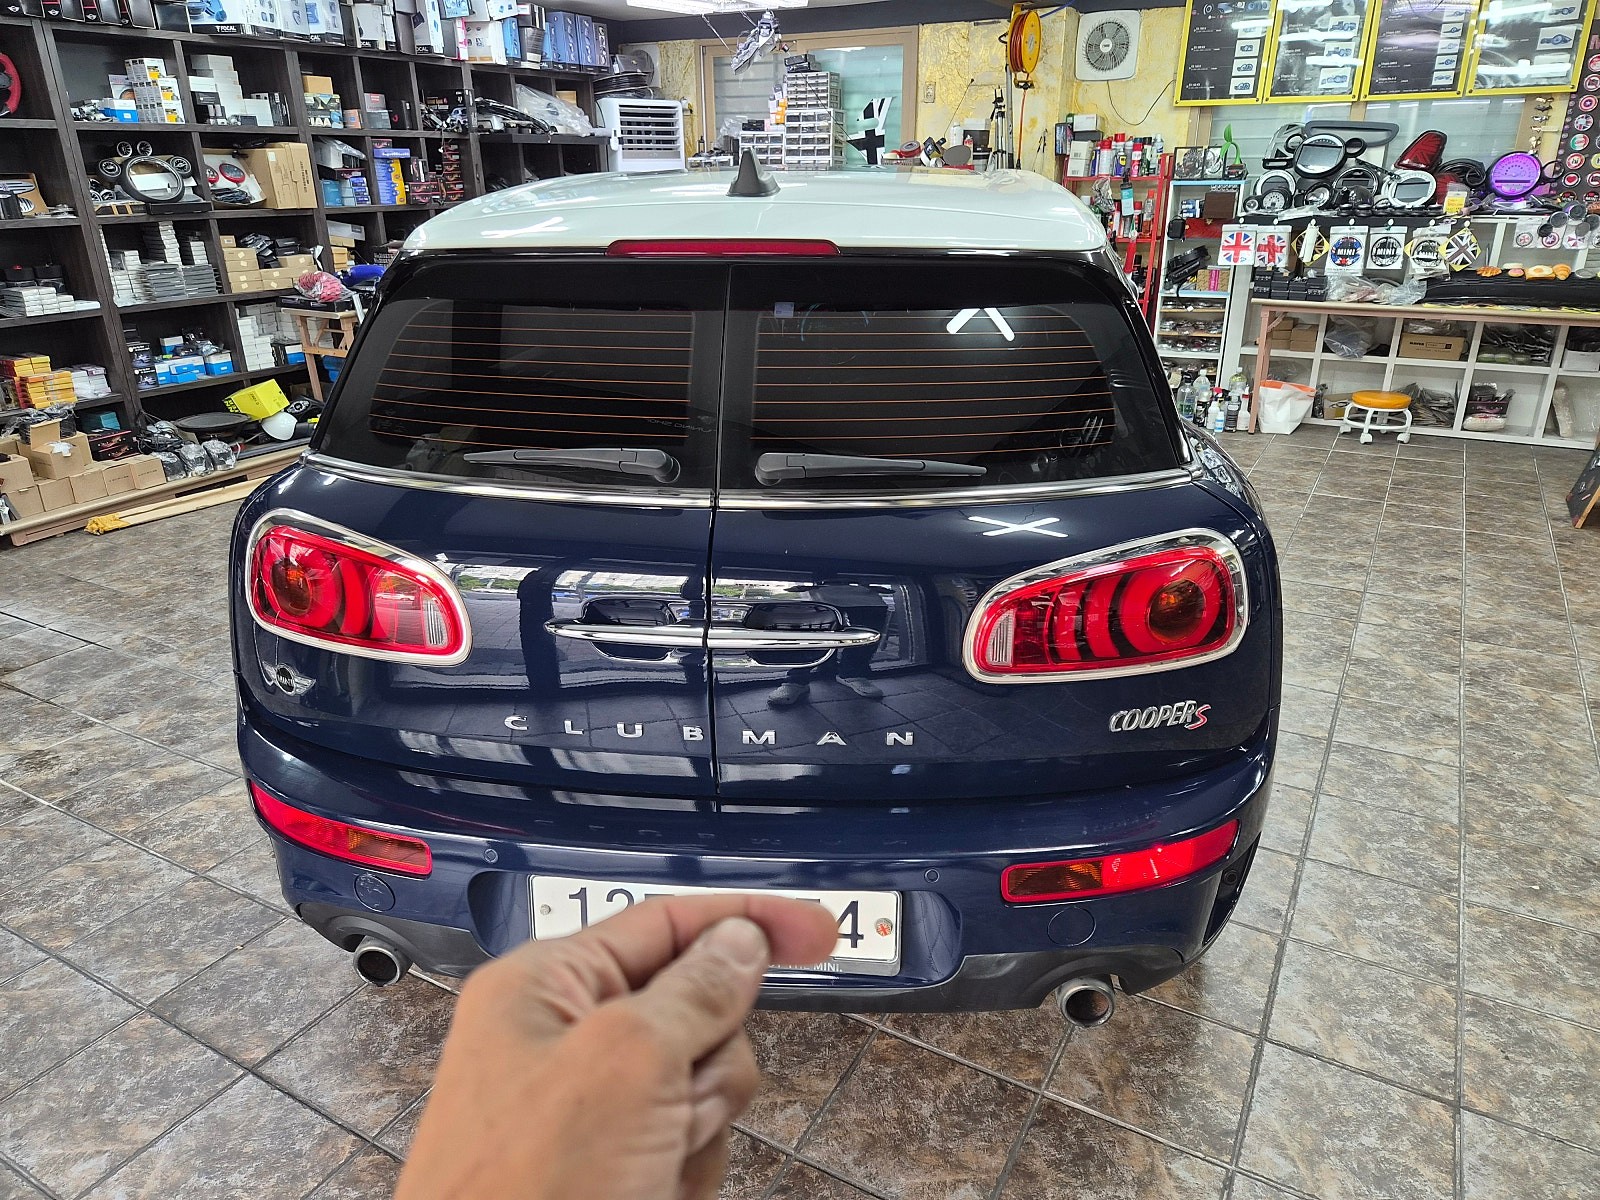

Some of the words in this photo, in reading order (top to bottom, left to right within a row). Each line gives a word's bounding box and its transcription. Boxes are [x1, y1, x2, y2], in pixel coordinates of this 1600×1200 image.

[1337, 248, 1356, 256] MINI
[1376, 248, 1396, 256] MINI
[277, 675, 295, 686] MINI
[1109, 700, 1197, 732] COOPER
[504, 714, 914, 746] CLUBMAN
